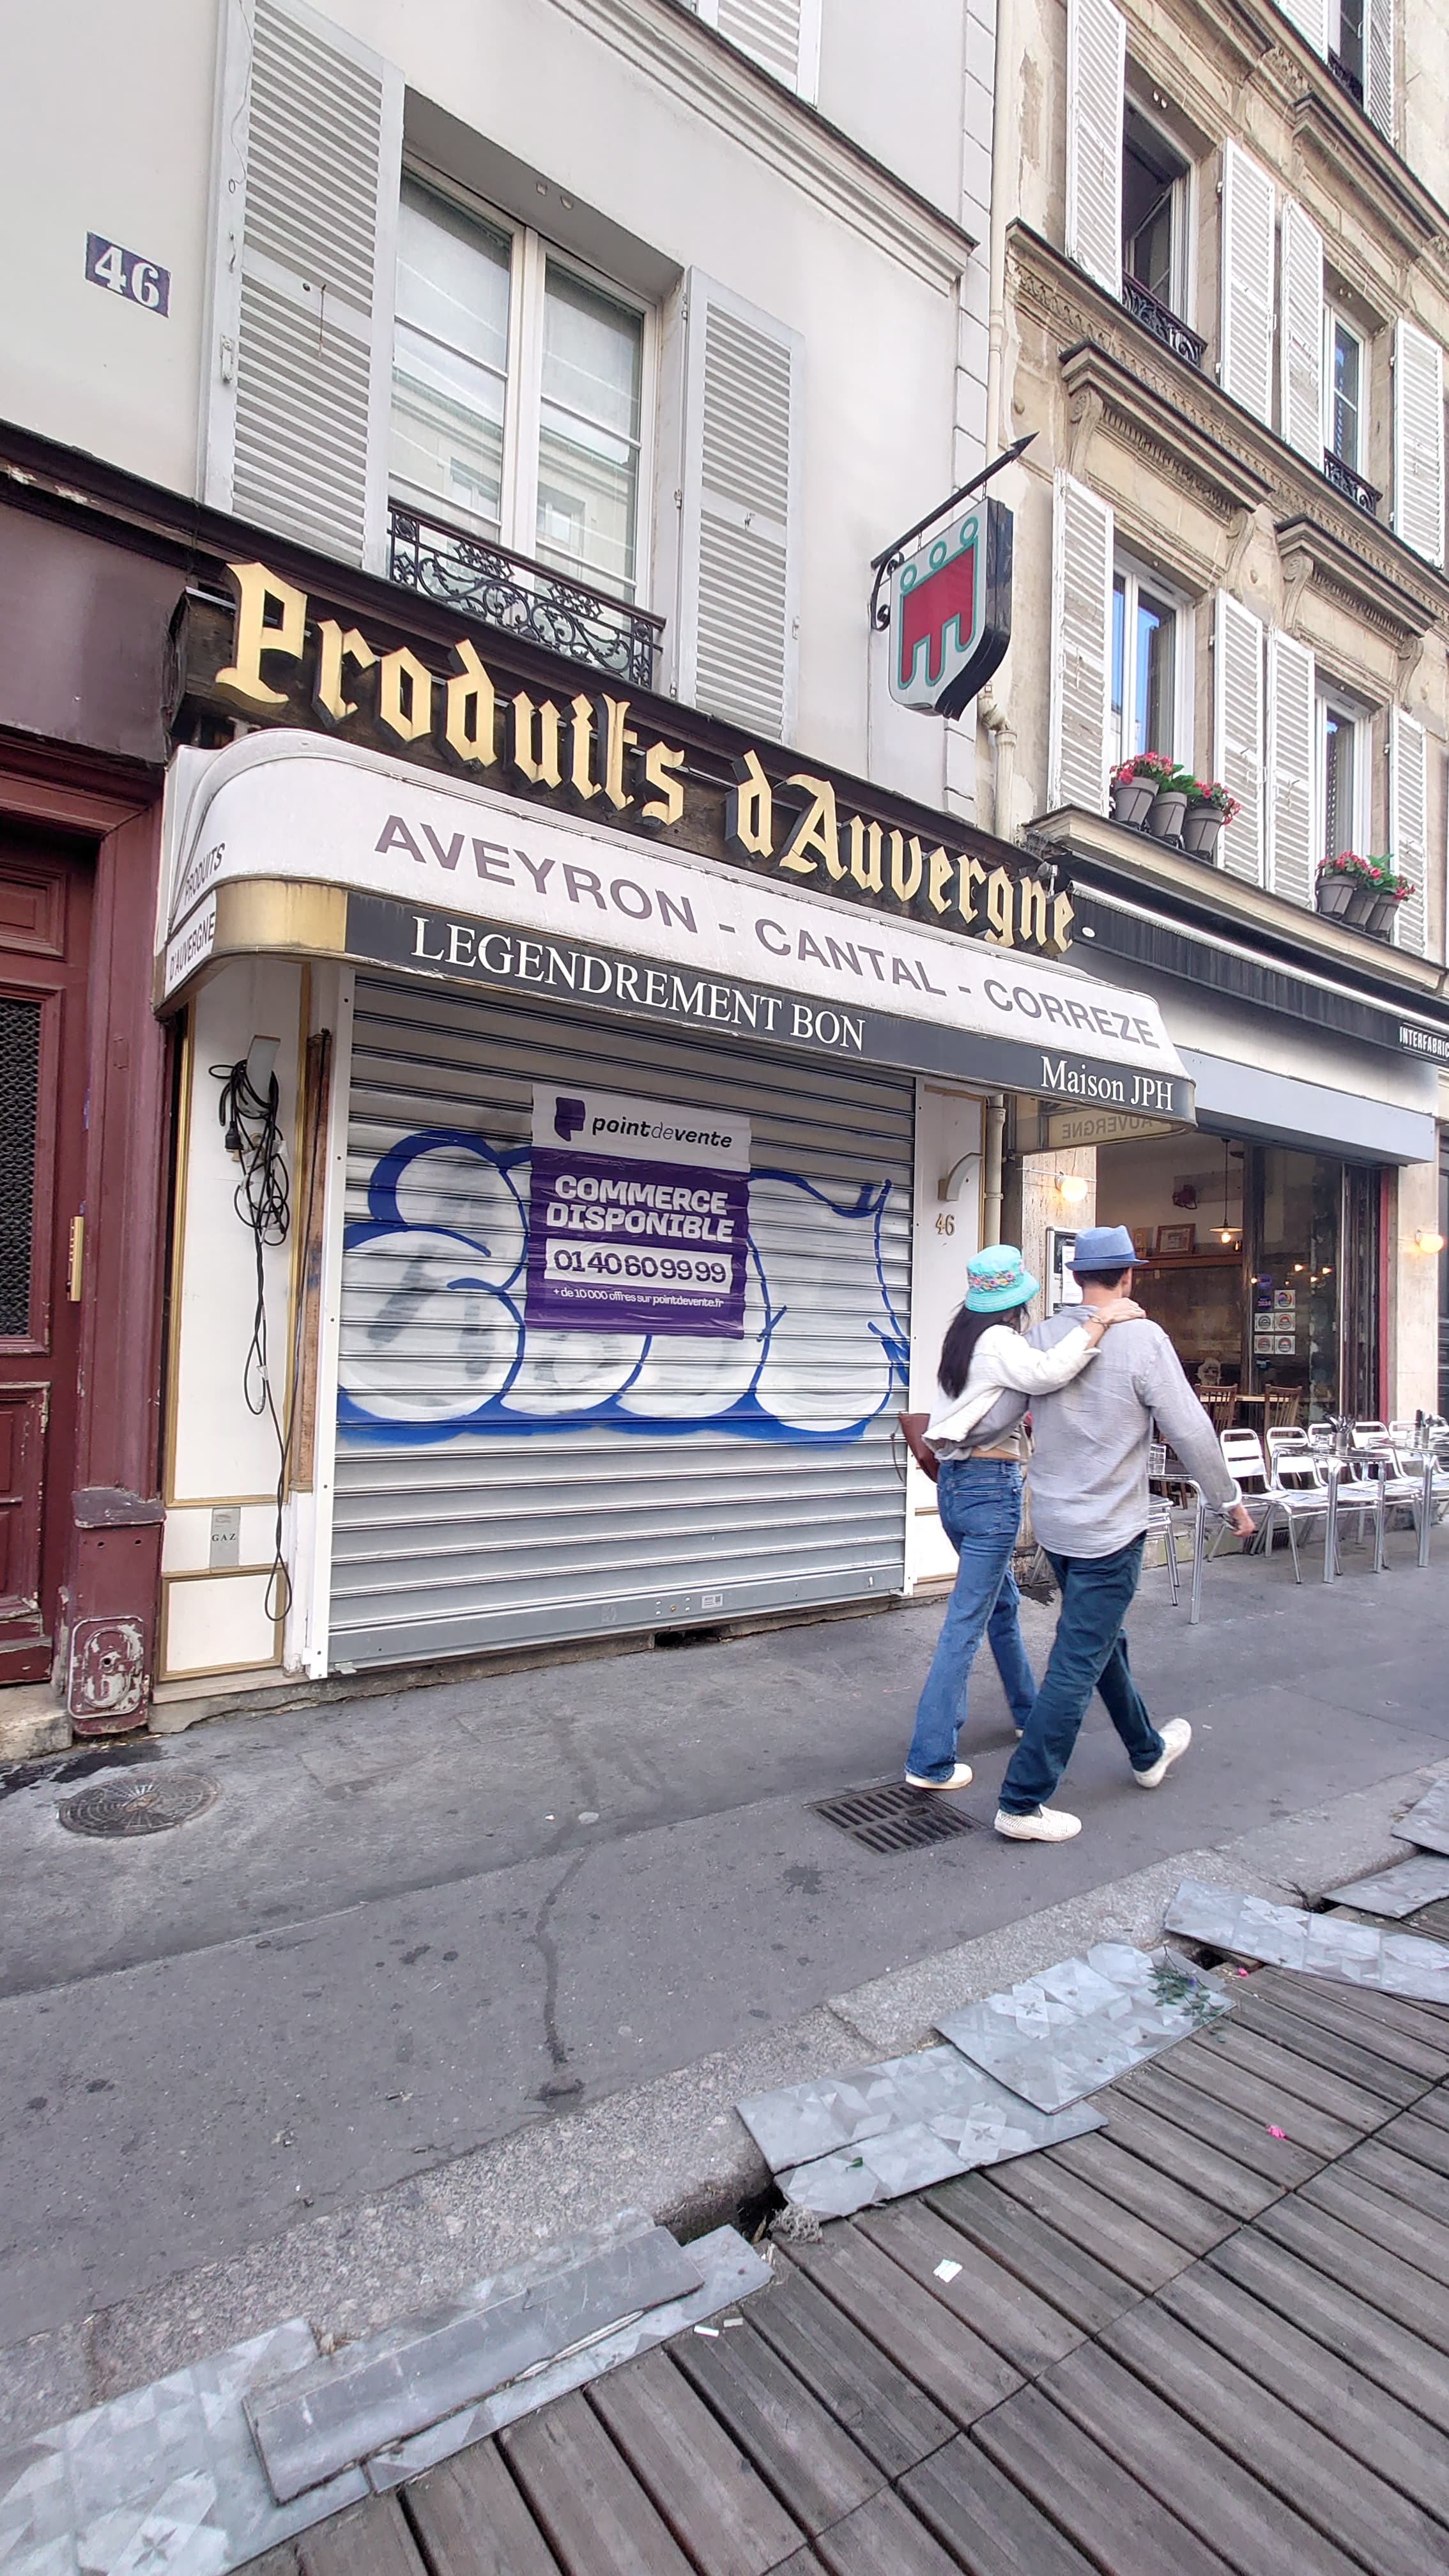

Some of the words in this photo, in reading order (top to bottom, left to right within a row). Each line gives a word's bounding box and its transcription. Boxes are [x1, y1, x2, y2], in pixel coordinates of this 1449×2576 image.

[94, 245, 159, 309] 46
[215, 562, 686, 826] Produits
[184, 843, 226, 906] PRODUITS
[169, 912, 215, 982] D'AUVERGNE
[374, 815, 698, 934] AVEYRON
[756, 918, 946, 997] CANTAL
[984, 979, 1160, 1049] CORREZE
[411, 916, 782, 1032] LEGENDREMENT
[791, 1003, 866, 1051] BON
[1041, 1056, 1126, 1103] Maison
[1130, 1075, 1174, 1112] JPH
[592, 1116, 733, 1149] pointdevente
[546, 1202, 735, 1243] DISPONIBLE
[555, 1174, 728, 1215] COMMERCE
[935, 1213, 954, 1236] 46
[561, 1287, 574, 1298] de
[609, 1291, 636, 1303] offres
[637, 1295, 652, 1303] sur
[652, 1294, 724, 1308] pointdevente.fr
[211, 1533, 236, 1542] GAZ
